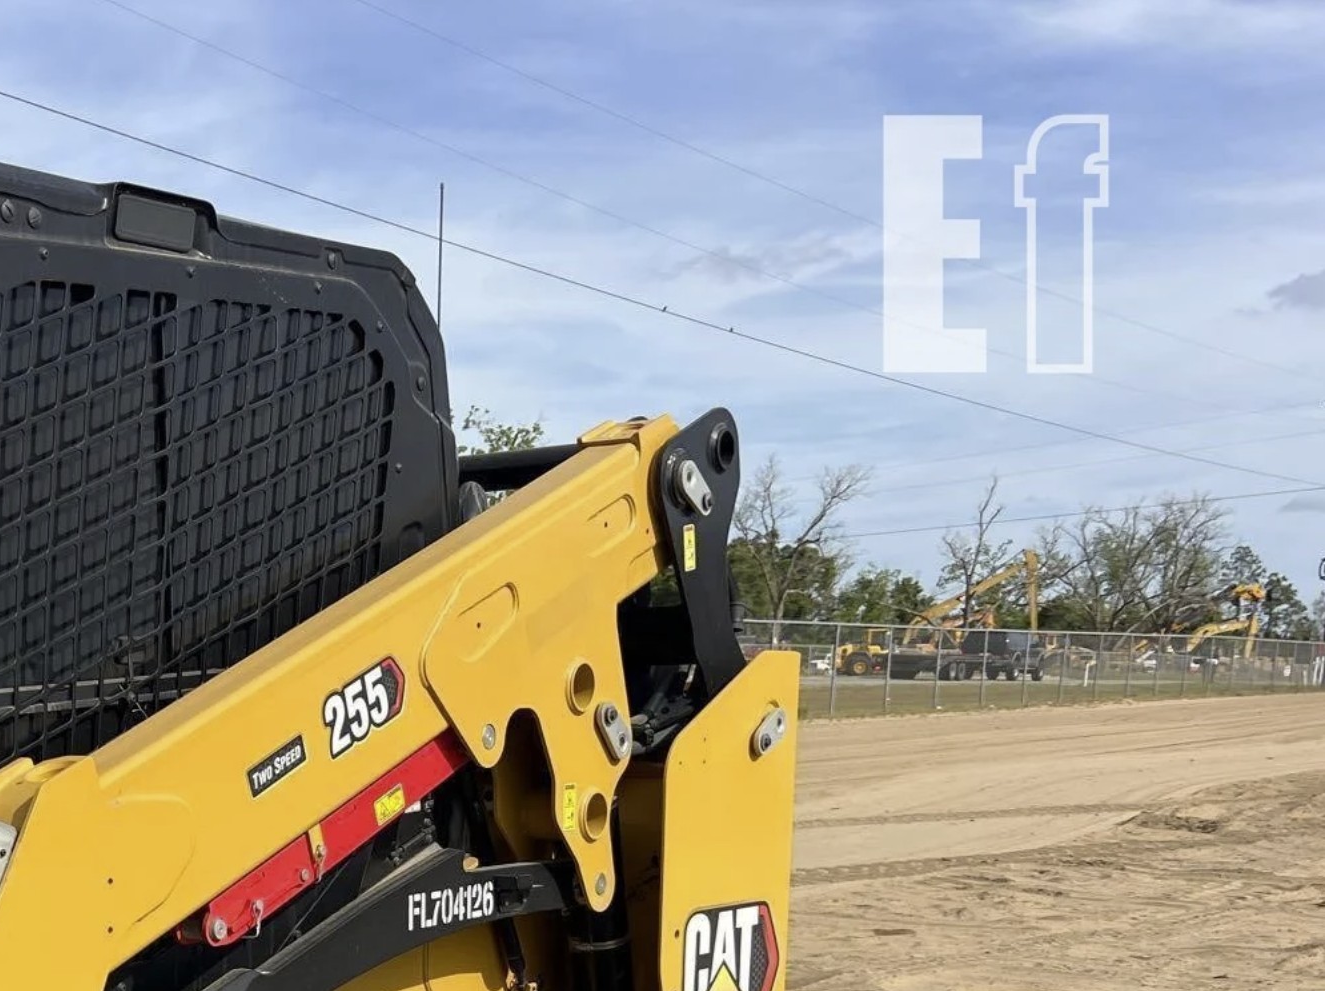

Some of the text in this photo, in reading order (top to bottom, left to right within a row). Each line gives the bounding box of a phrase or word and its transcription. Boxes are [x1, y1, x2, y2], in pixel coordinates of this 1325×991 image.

[325, 665, 390, 756] 255
[252, 744, 302, 790] TWO SPEED
[408, 880, 495, 932] FL704126
